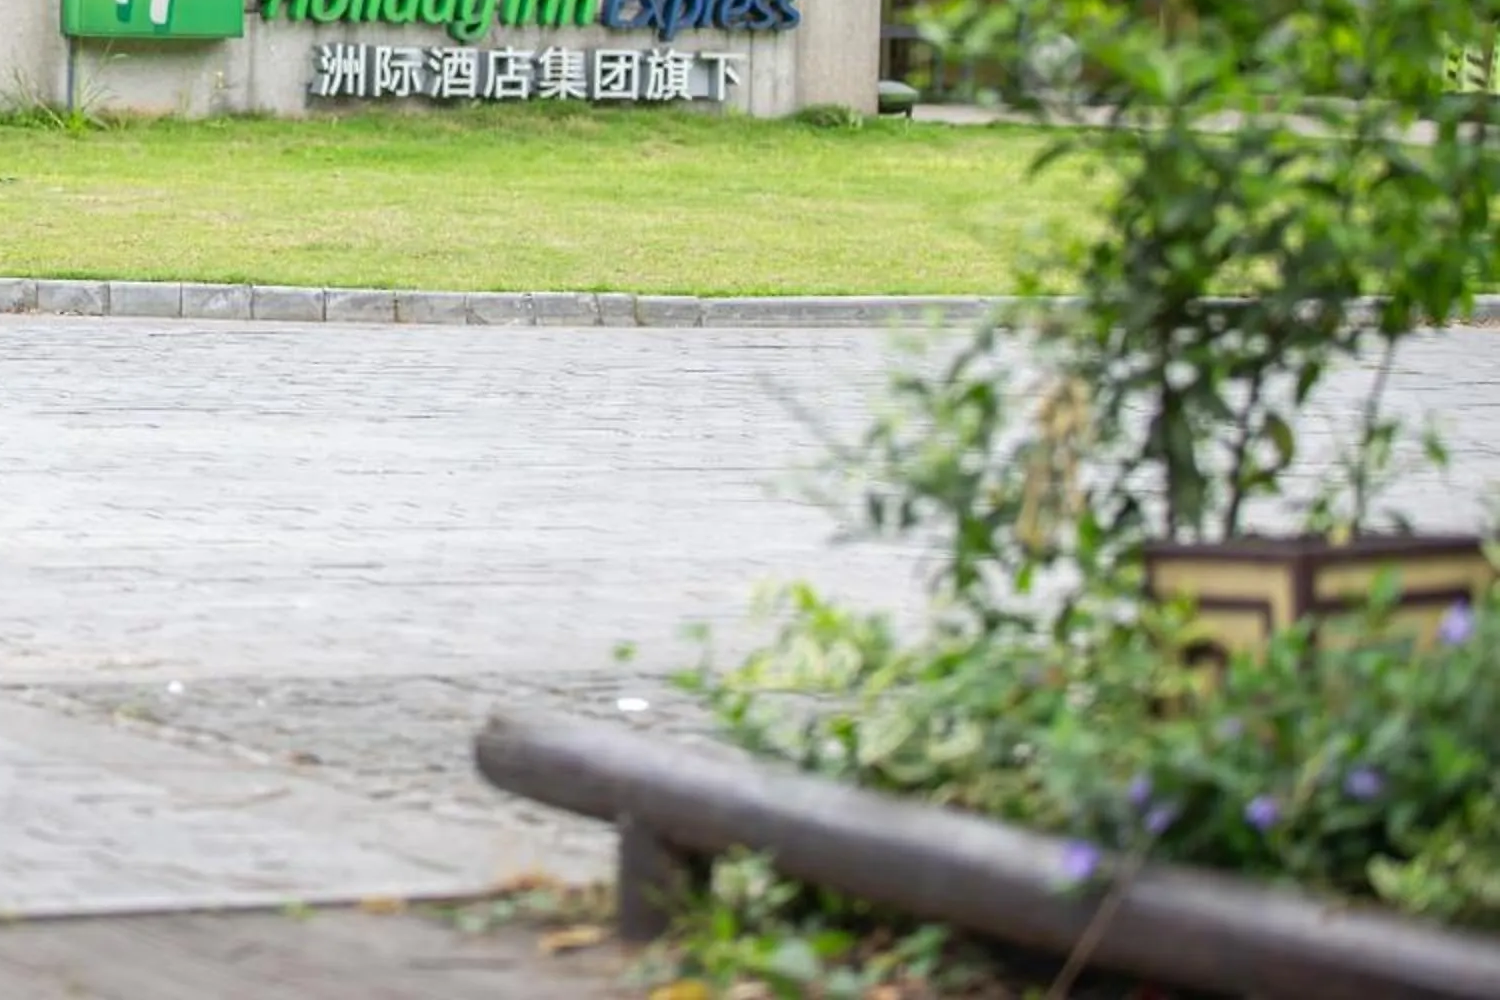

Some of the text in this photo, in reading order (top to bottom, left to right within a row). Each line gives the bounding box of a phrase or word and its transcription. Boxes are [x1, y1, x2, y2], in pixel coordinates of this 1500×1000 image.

[315, 43, 747, 101] 洲际酒店集团旗下
